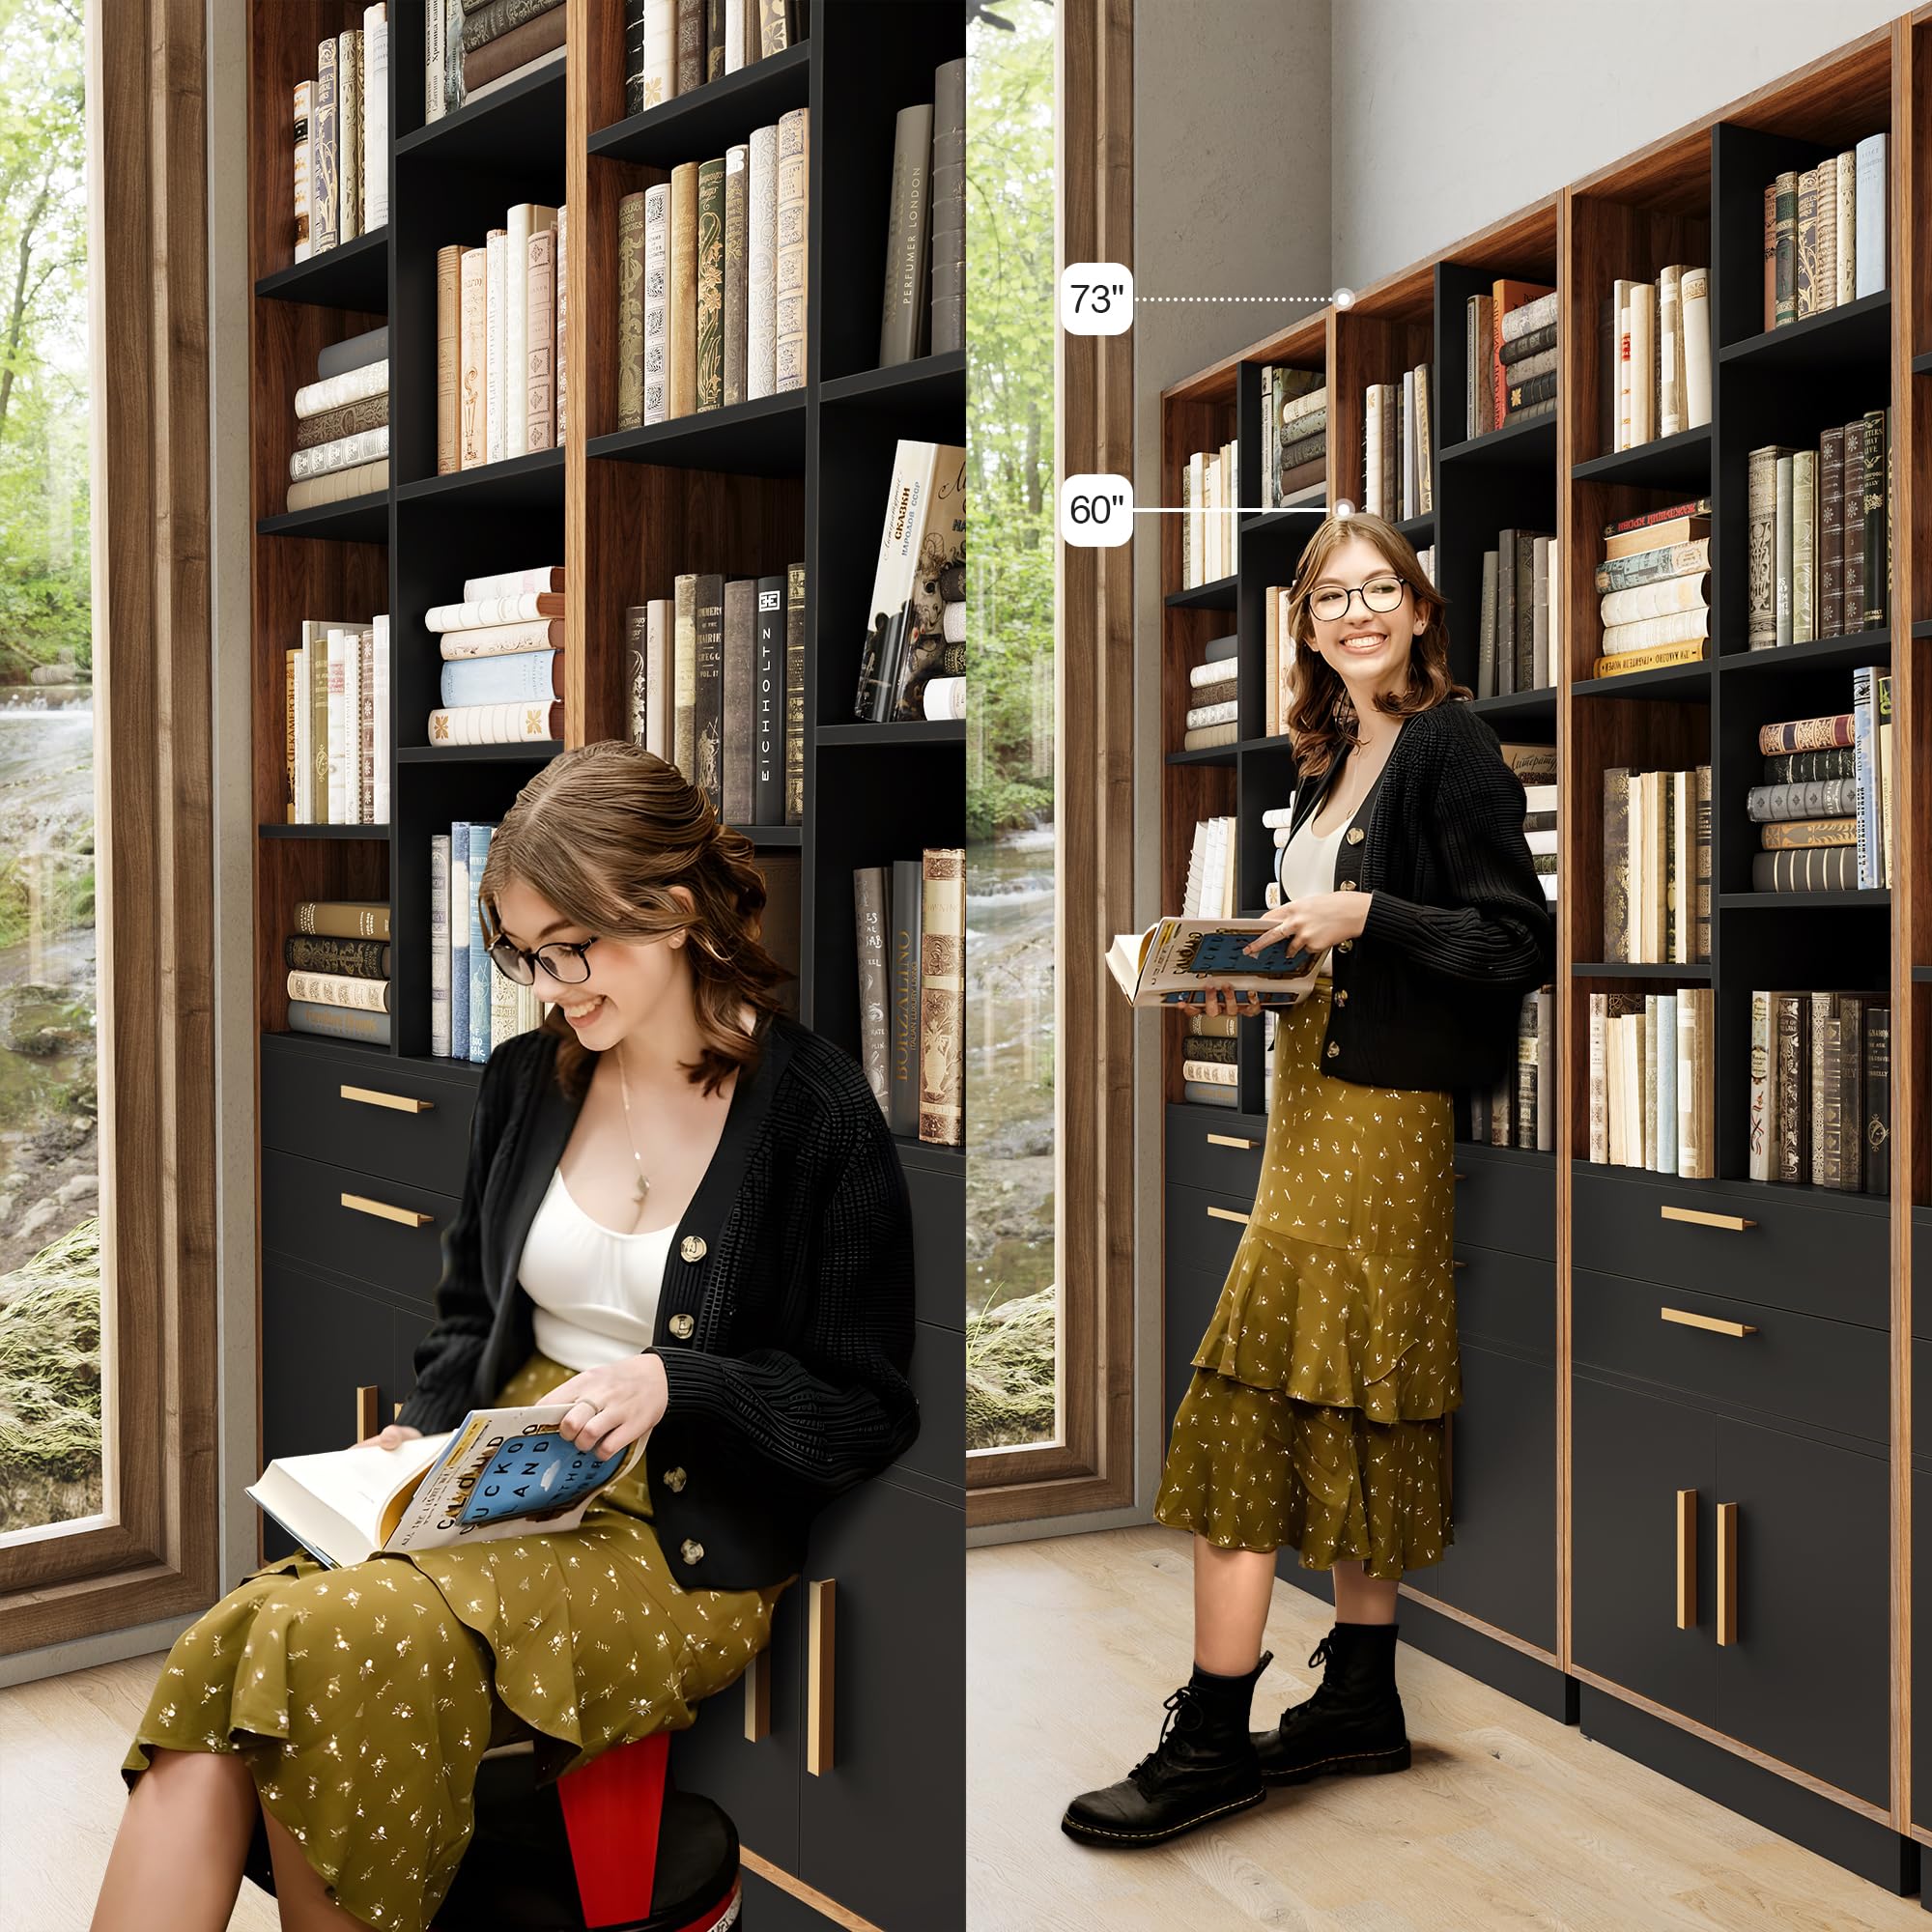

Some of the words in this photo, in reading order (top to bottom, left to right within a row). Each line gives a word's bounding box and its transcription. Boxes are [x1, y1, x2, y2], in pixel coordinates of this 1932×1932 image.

[908, 167, 921, 228] LONDON
[902, 235, 917, 304] PERFUMER
[895, 487, 910, 540] СКАЗКИ
[901, 511, 915, 556] НАРОДОВ
[911, 481, 921, 507] СССР
[761, 628, 771, 781] EICHHOLTZ
[437, 1435, 503, 1531] CLOUD
